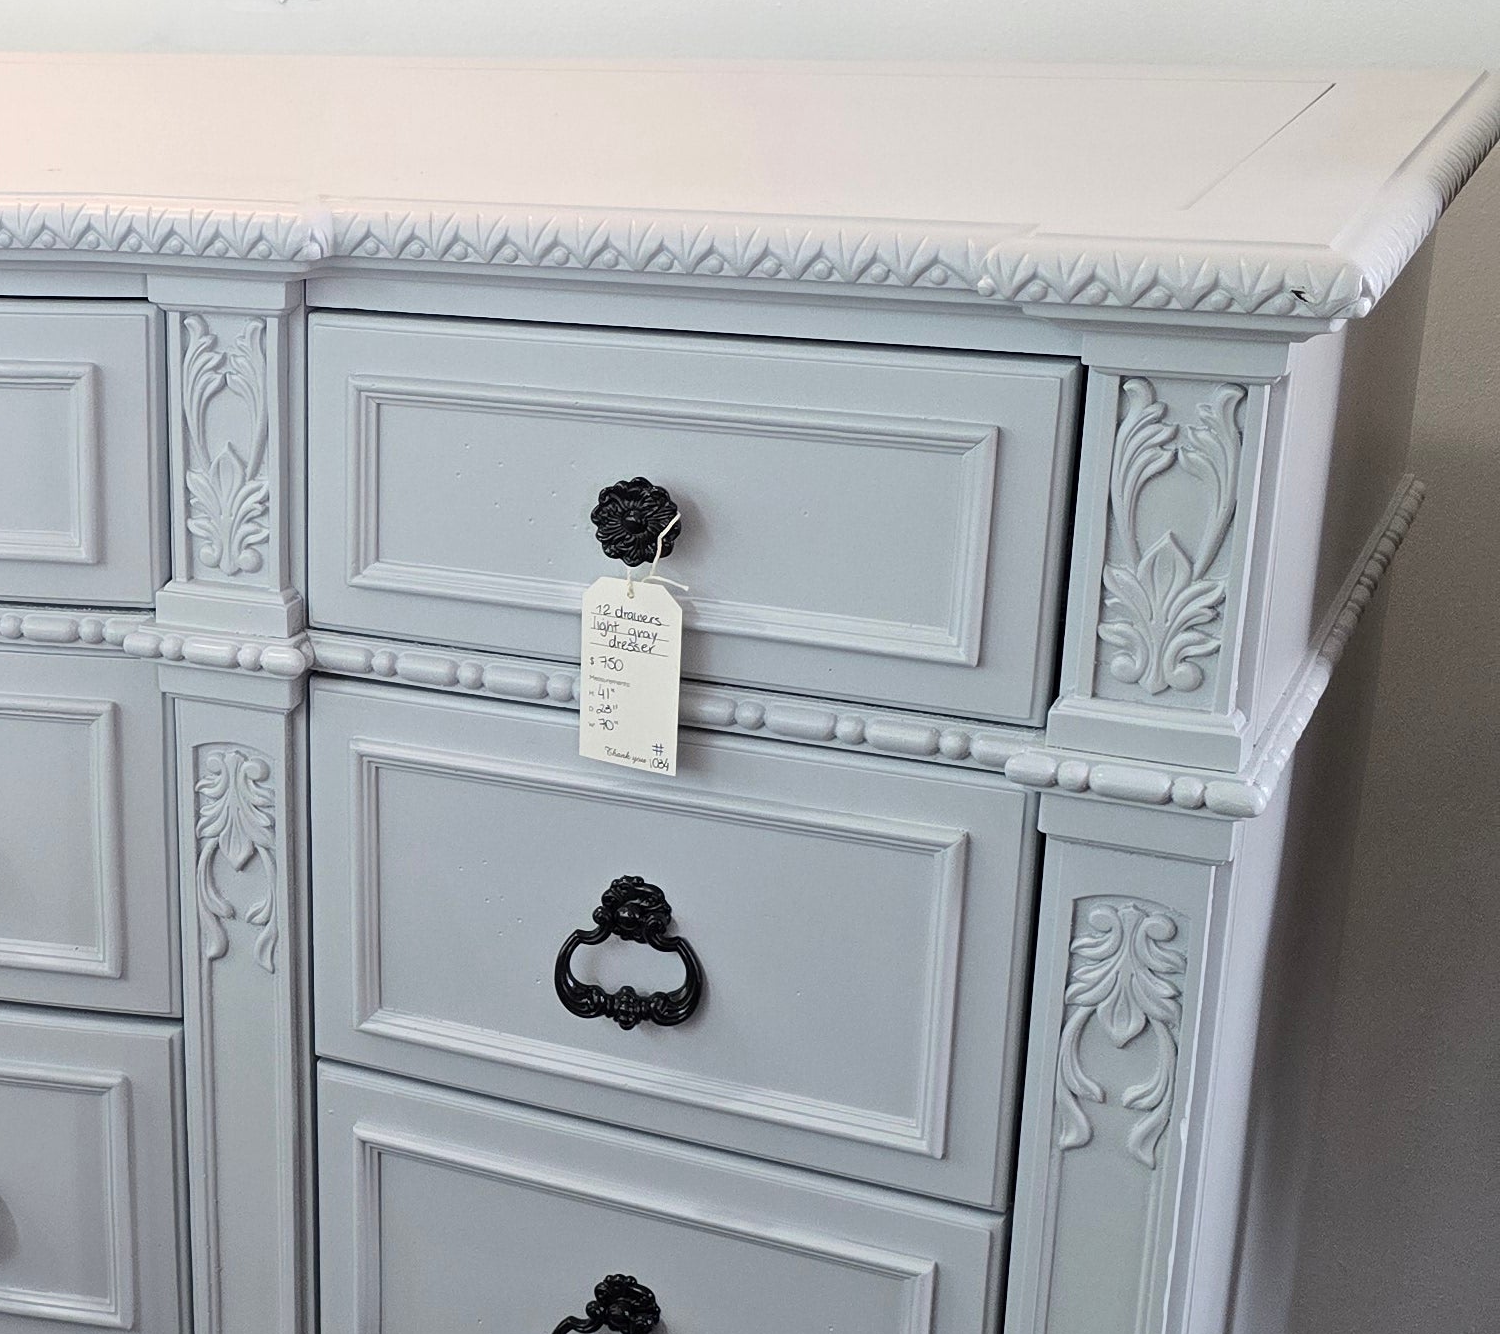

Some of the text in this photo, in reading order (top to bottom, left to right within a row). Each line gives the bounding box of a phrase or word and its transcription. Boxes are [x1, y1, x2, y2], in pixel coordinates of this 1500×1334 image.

[596, 604, 662, 626] 12 drawers
[593, 616, 658, 645] light gray
[608, 635, 656, 654] dresser
[589, 656, 624, 671] $ 750
[604, 745, 631, 760] Thank
[651, 743, 664, 756] #
